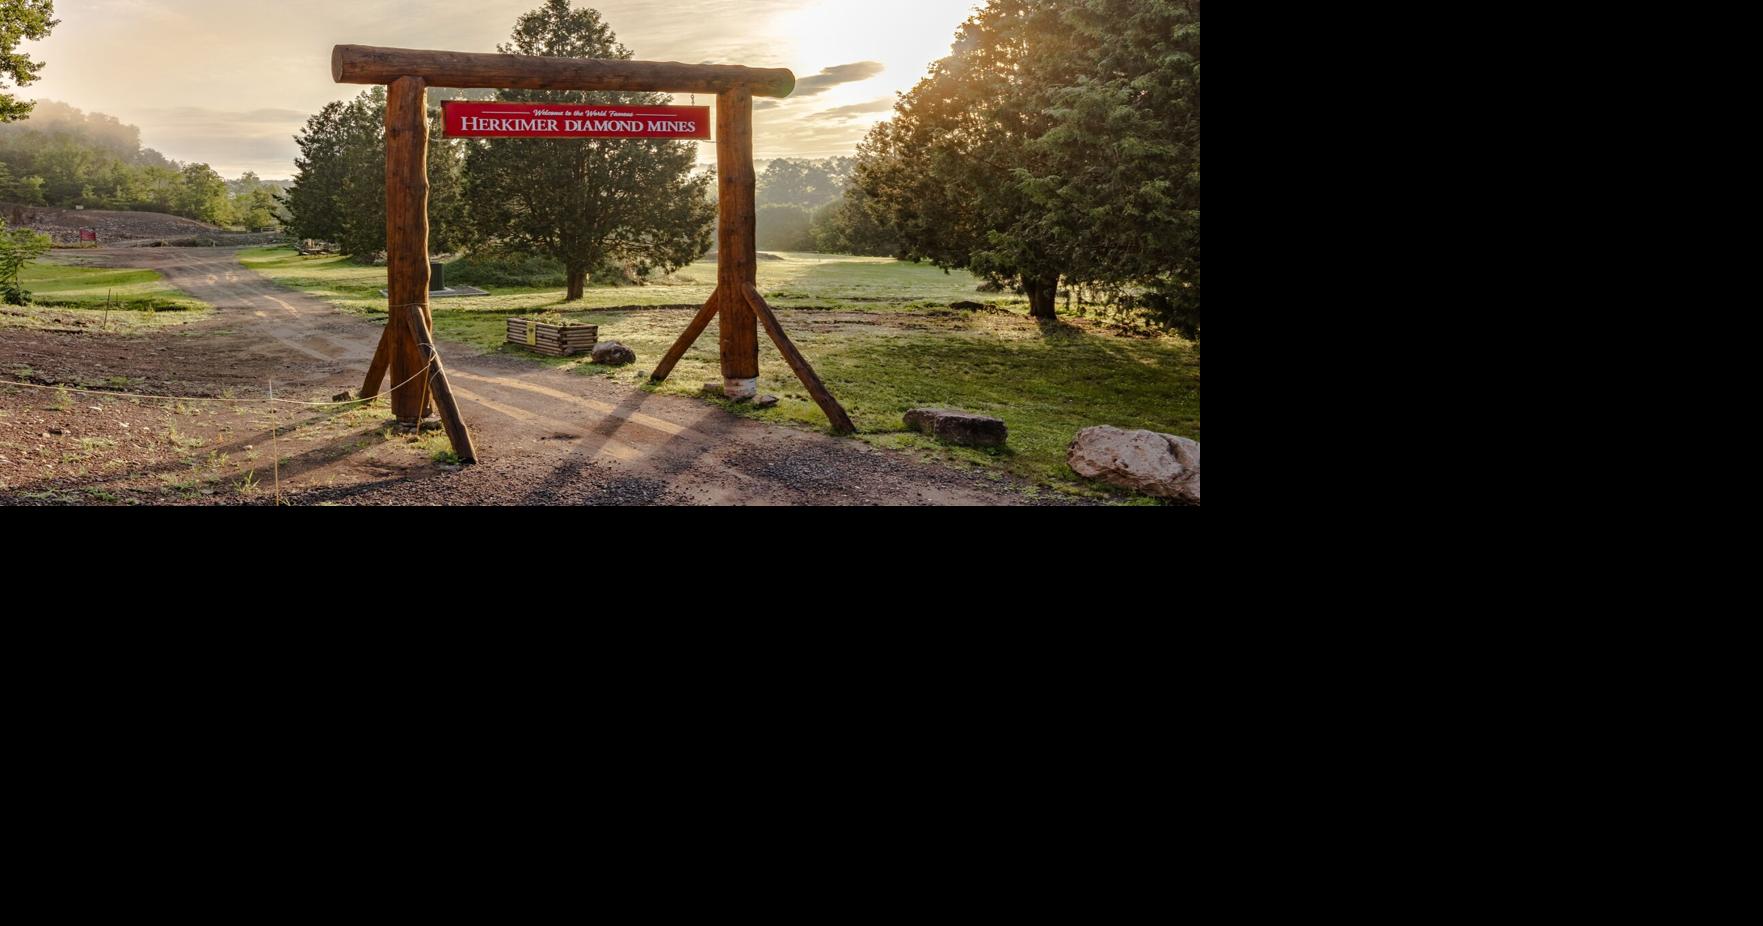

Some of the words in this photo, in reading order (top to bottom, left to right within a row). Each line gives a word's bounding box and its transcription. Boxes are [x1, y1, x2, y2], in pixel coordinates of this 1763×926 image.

[533, 109, 563, 117] Welcome
[573, 109, 584, 117] the
[585, 109, 607, 117] World
[460, 116, 560, 132] HERKIMER
[564, 119, 644, 132] DIAMOND
[647, 120, 697, 133] MINES
